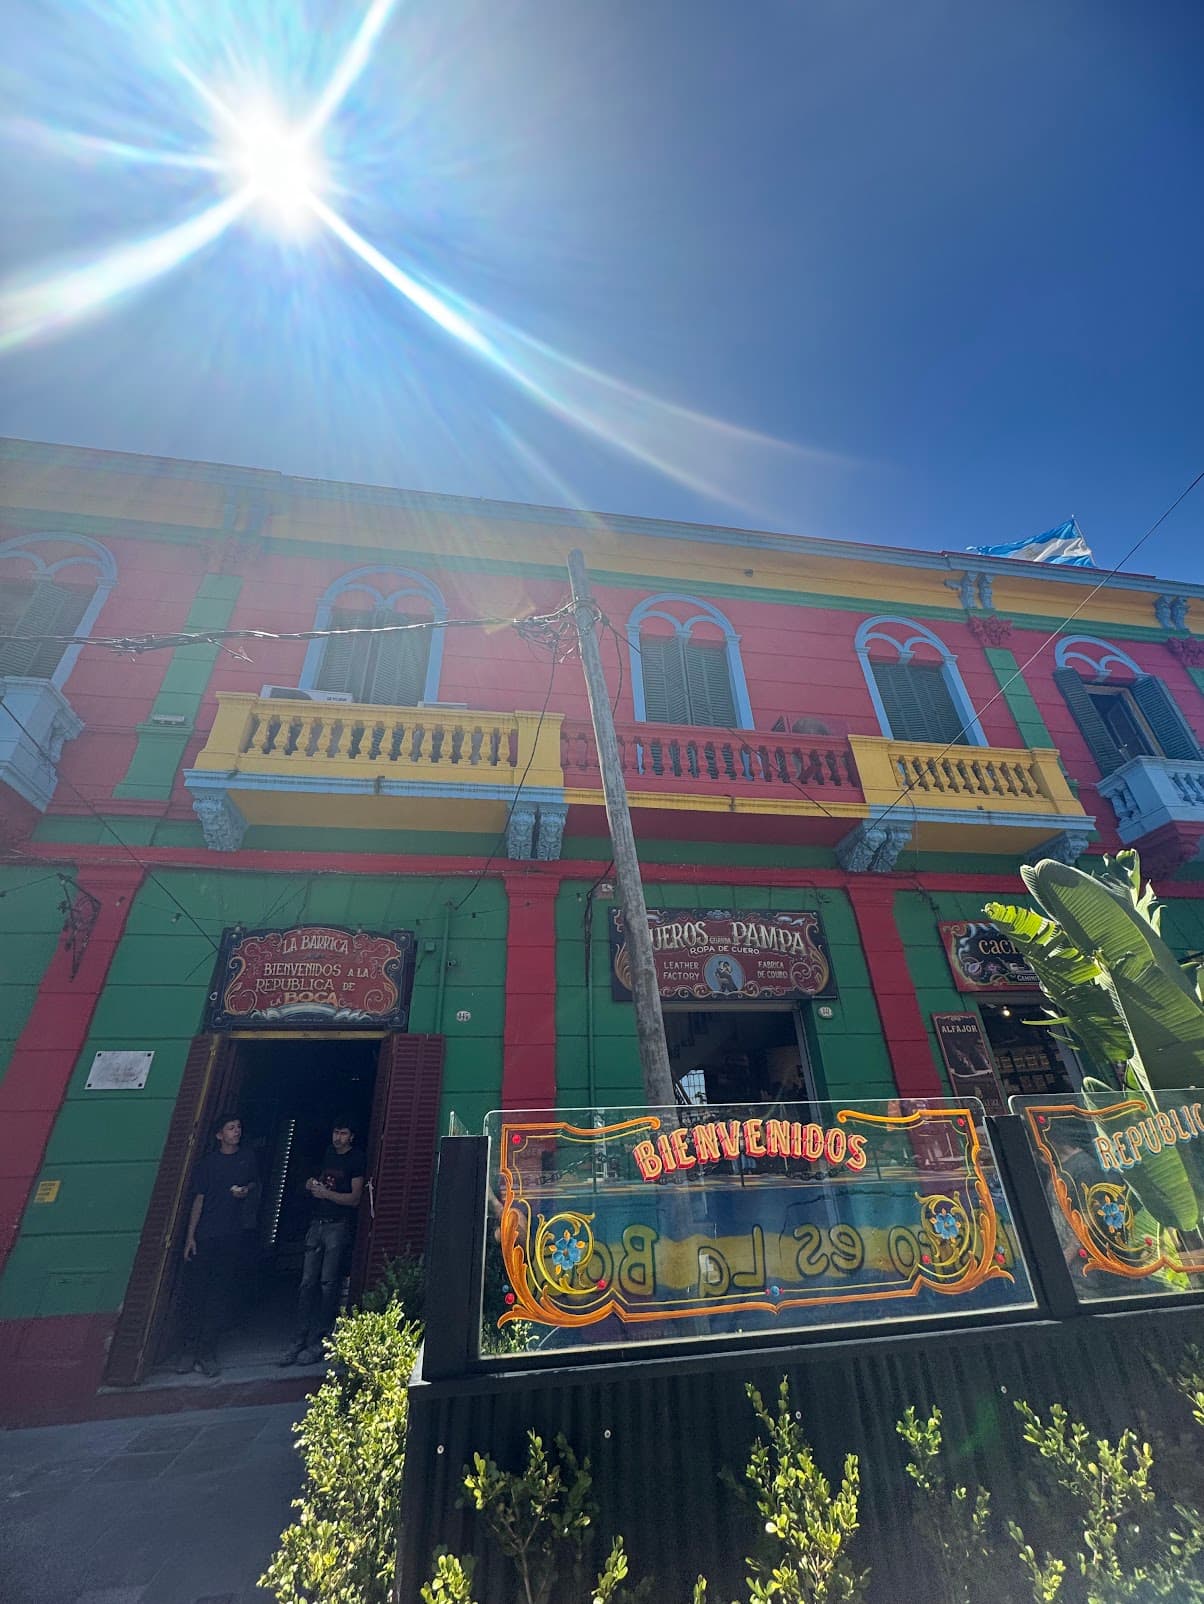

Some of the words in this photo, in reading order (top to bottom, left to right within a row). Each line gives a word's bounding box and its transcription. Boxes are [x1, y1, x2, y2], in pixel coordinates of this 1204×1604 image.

[282, 938, 298, 955] LA
[301, 935, 349, 955] BARRICA
[649, 921, 709, 950] UEROS
[730, 921, 807, 956] PAMPA
[690, 945, 716, 955] ROPA
[731, 946, 760, 955] CUERO
[263, 962, 342, 977] BIENVENIDOS
[347, 969, 354, 977] A
[357, 967, 370, 978] LA
[663, 961, 700, 970] LEATHER
[758, 960, 785, 969] FABRICA
[663, 971, 701, 981] FACTORY
[757, 970, 766, 979] DE
[255, 978, 335, 994] REPUBLICA
[342, 982, 356, 992] DE
[270, 998, 281, 1006] LA
[284, 991, 340, 1007] BOCA
[942, 1025, 978, 1033] ALFAJOR
[632, 1118, 868, 1182] BIENVENIDOS
